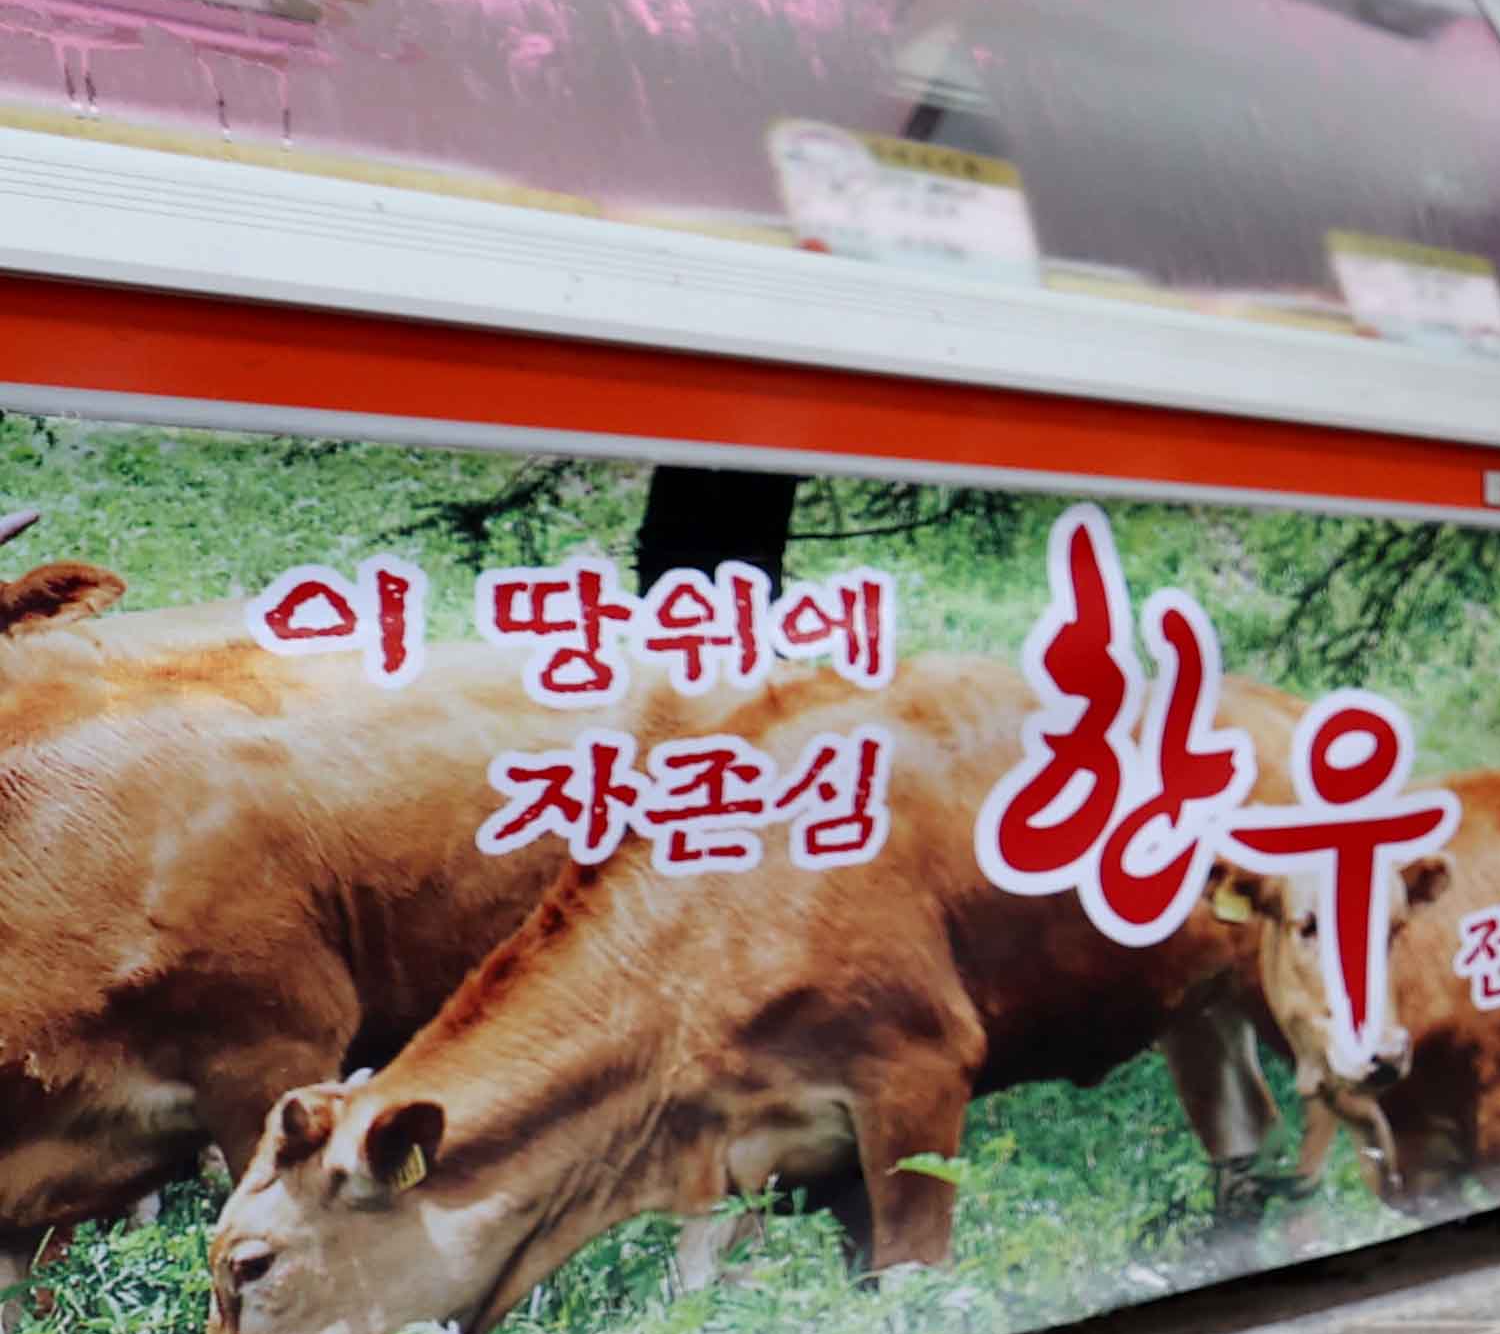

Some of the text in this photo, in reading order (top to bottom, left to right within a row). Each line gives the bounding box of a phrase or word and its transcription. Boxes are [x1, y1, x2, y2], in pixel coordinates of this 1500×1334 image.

[264, 567, 884, 696] 이 땅위에
[494, 738, 881, 864] 자존심
